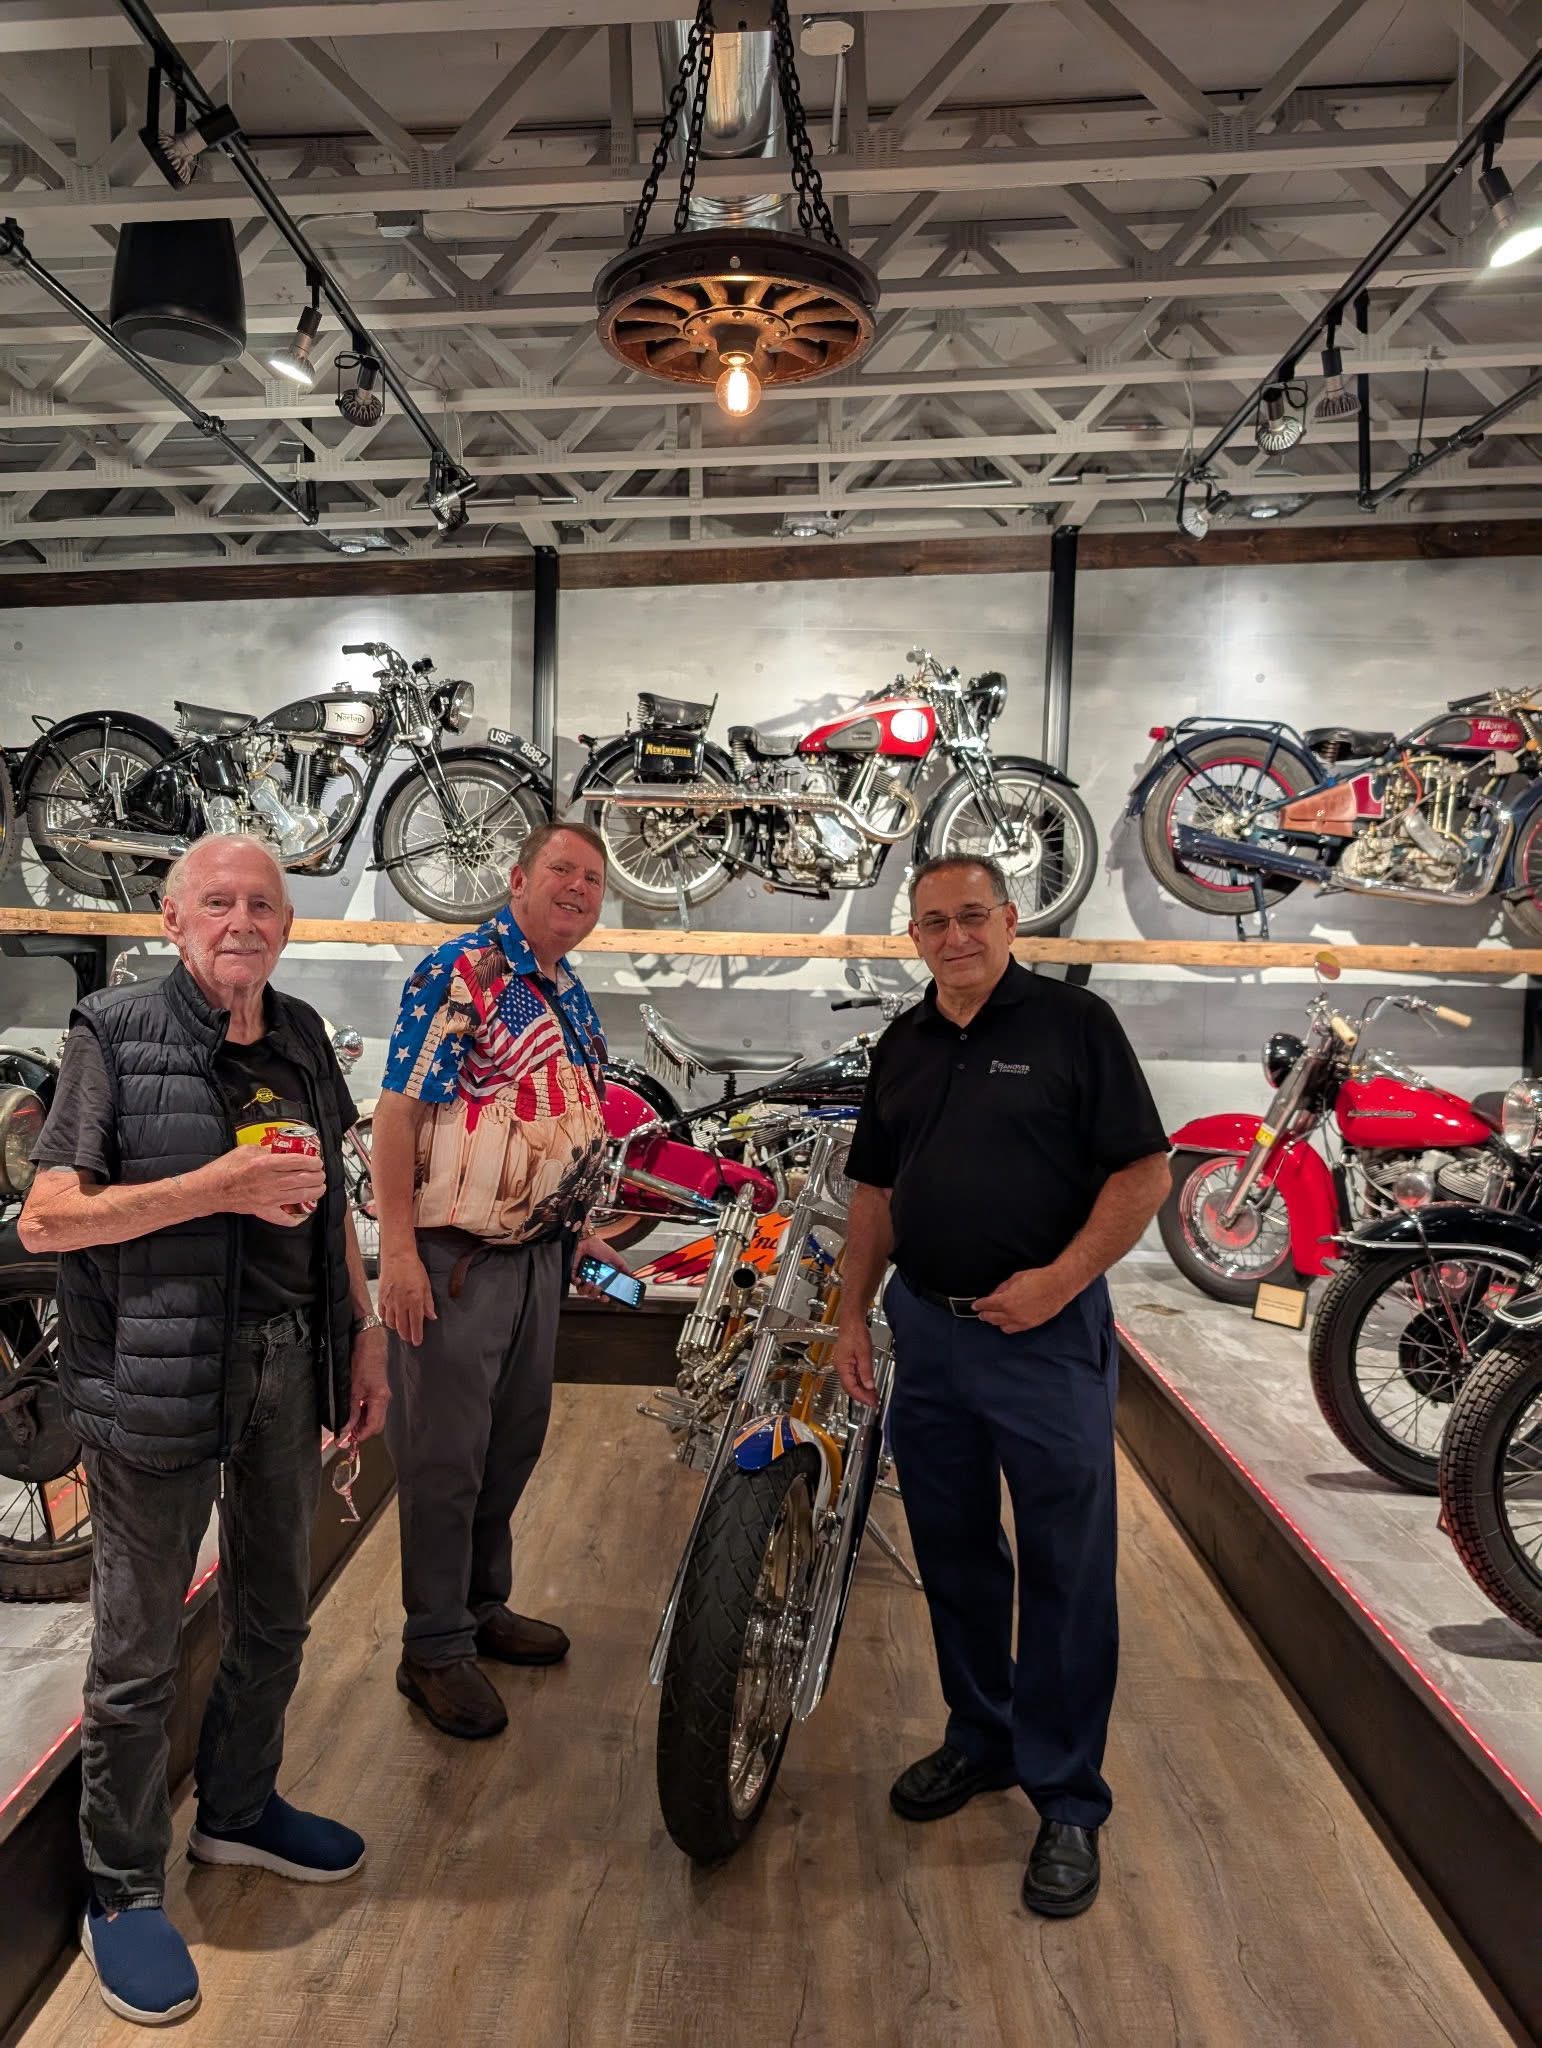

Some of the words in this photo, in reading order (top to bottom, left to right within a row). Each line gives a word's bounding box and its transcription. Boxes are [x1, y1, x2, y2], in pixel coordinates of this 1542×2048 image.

[335, 712, 366, 724] Norton
[490, 729, 514, 745] USF
[520, 742, 548, 767] 8984
